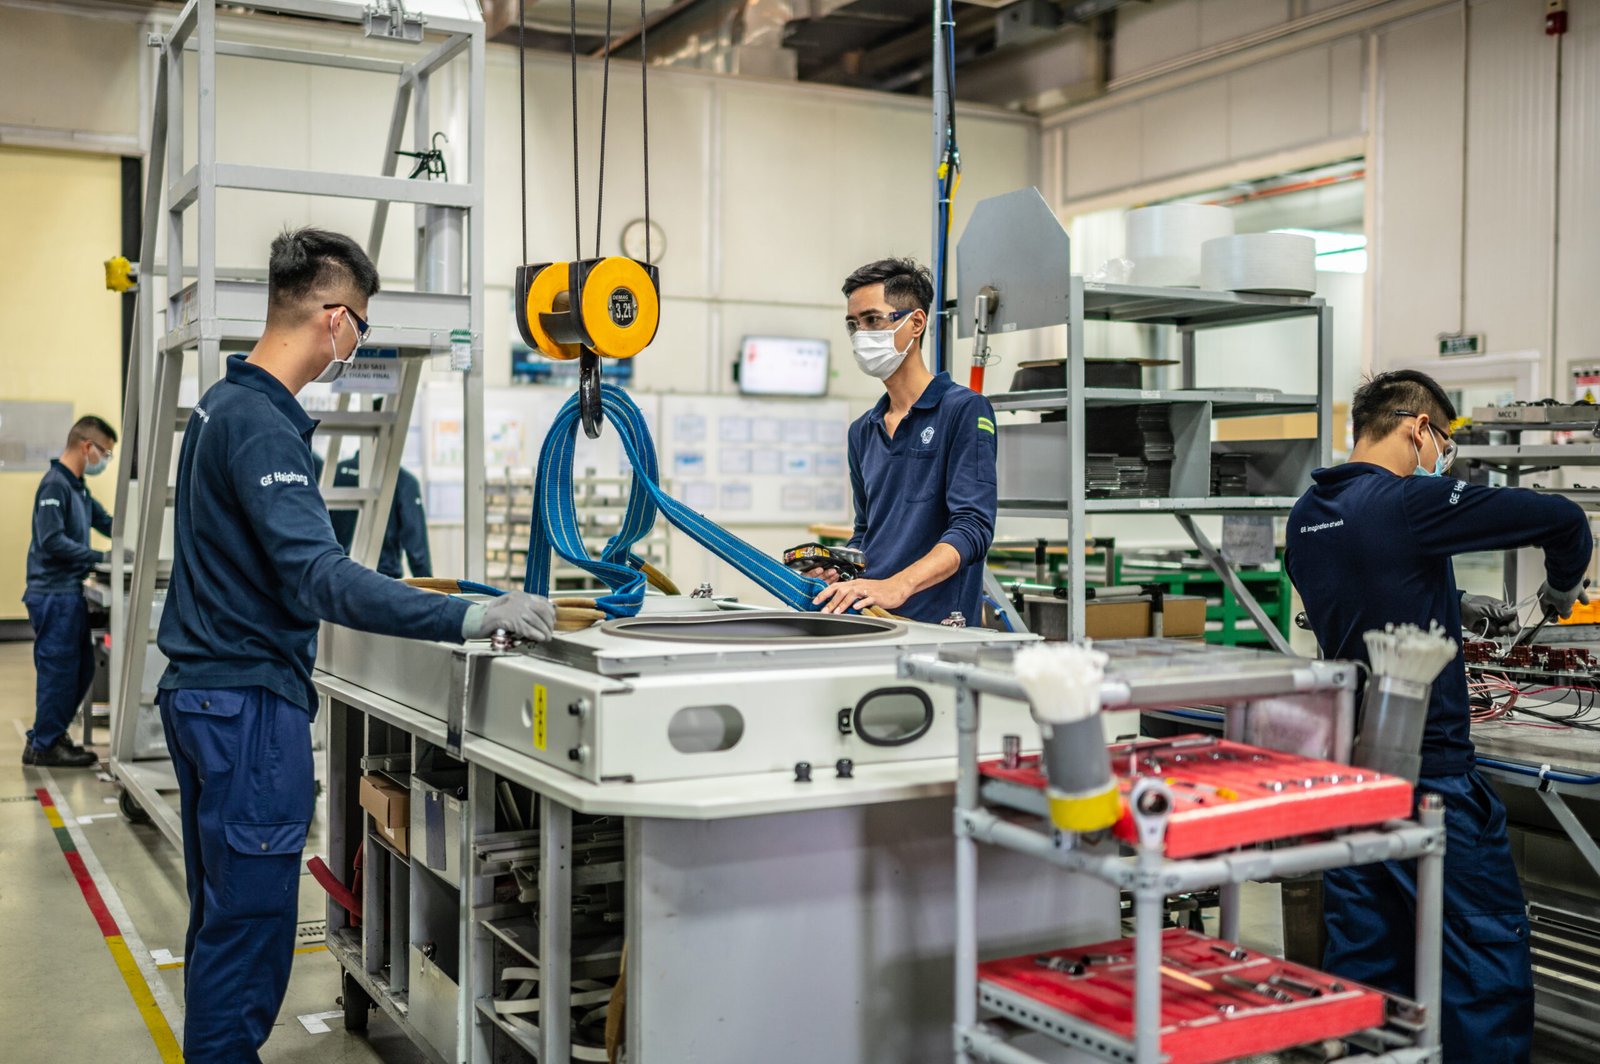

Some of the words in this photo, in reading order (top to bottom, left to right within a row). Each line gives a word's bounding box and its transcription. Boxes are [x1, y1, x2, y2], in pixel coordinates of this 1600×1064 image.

[260, 474, 273, 486] GE
[273, 471, 309, 486] Haiphong
[1449, 492, 1461, 504] GE
